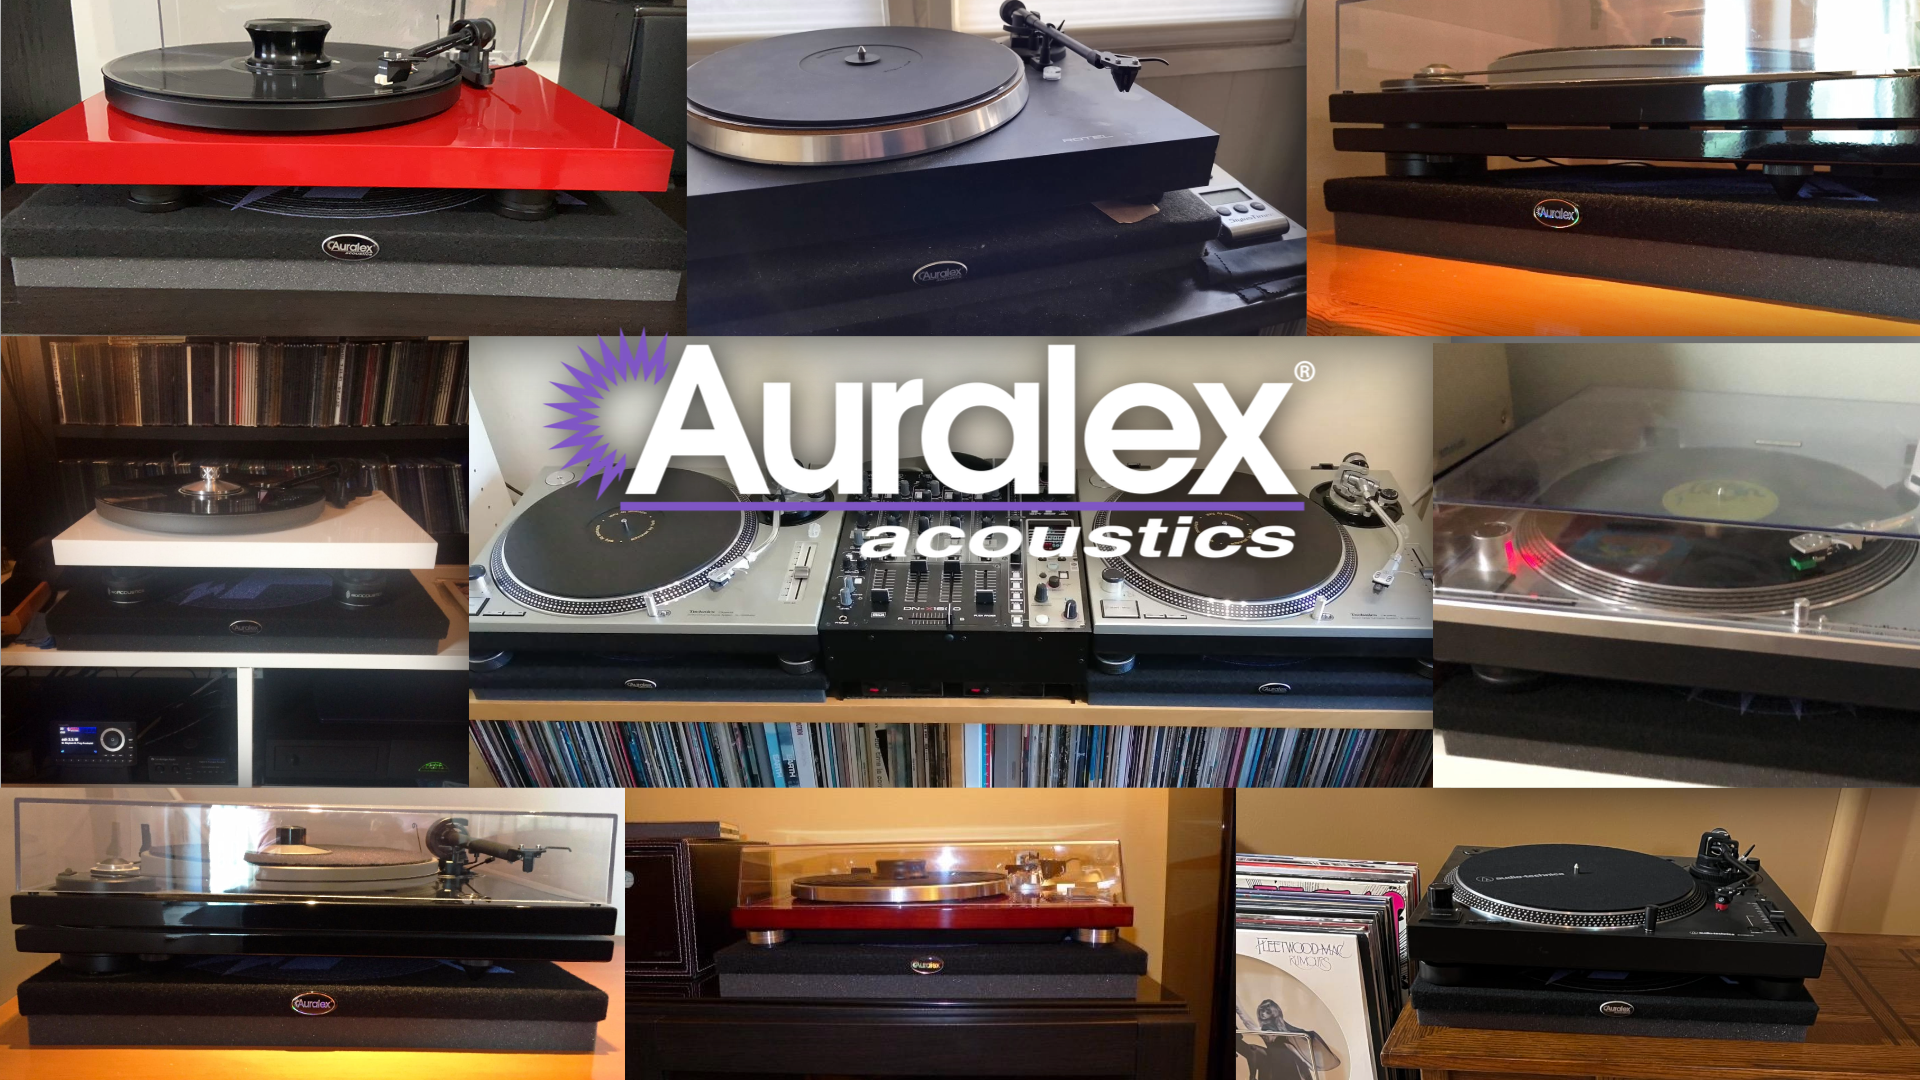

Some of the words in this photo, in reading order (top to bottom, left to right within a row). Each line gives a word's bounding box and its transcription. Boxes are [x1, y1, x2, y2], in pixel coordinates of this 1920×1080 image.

[1540, 206, 1575, 221] Auralex
[330, 240, 374, 254] Auralex
[921, 267, 962, 281] Auralex
[299, 998, 331, 1009] Auralex
